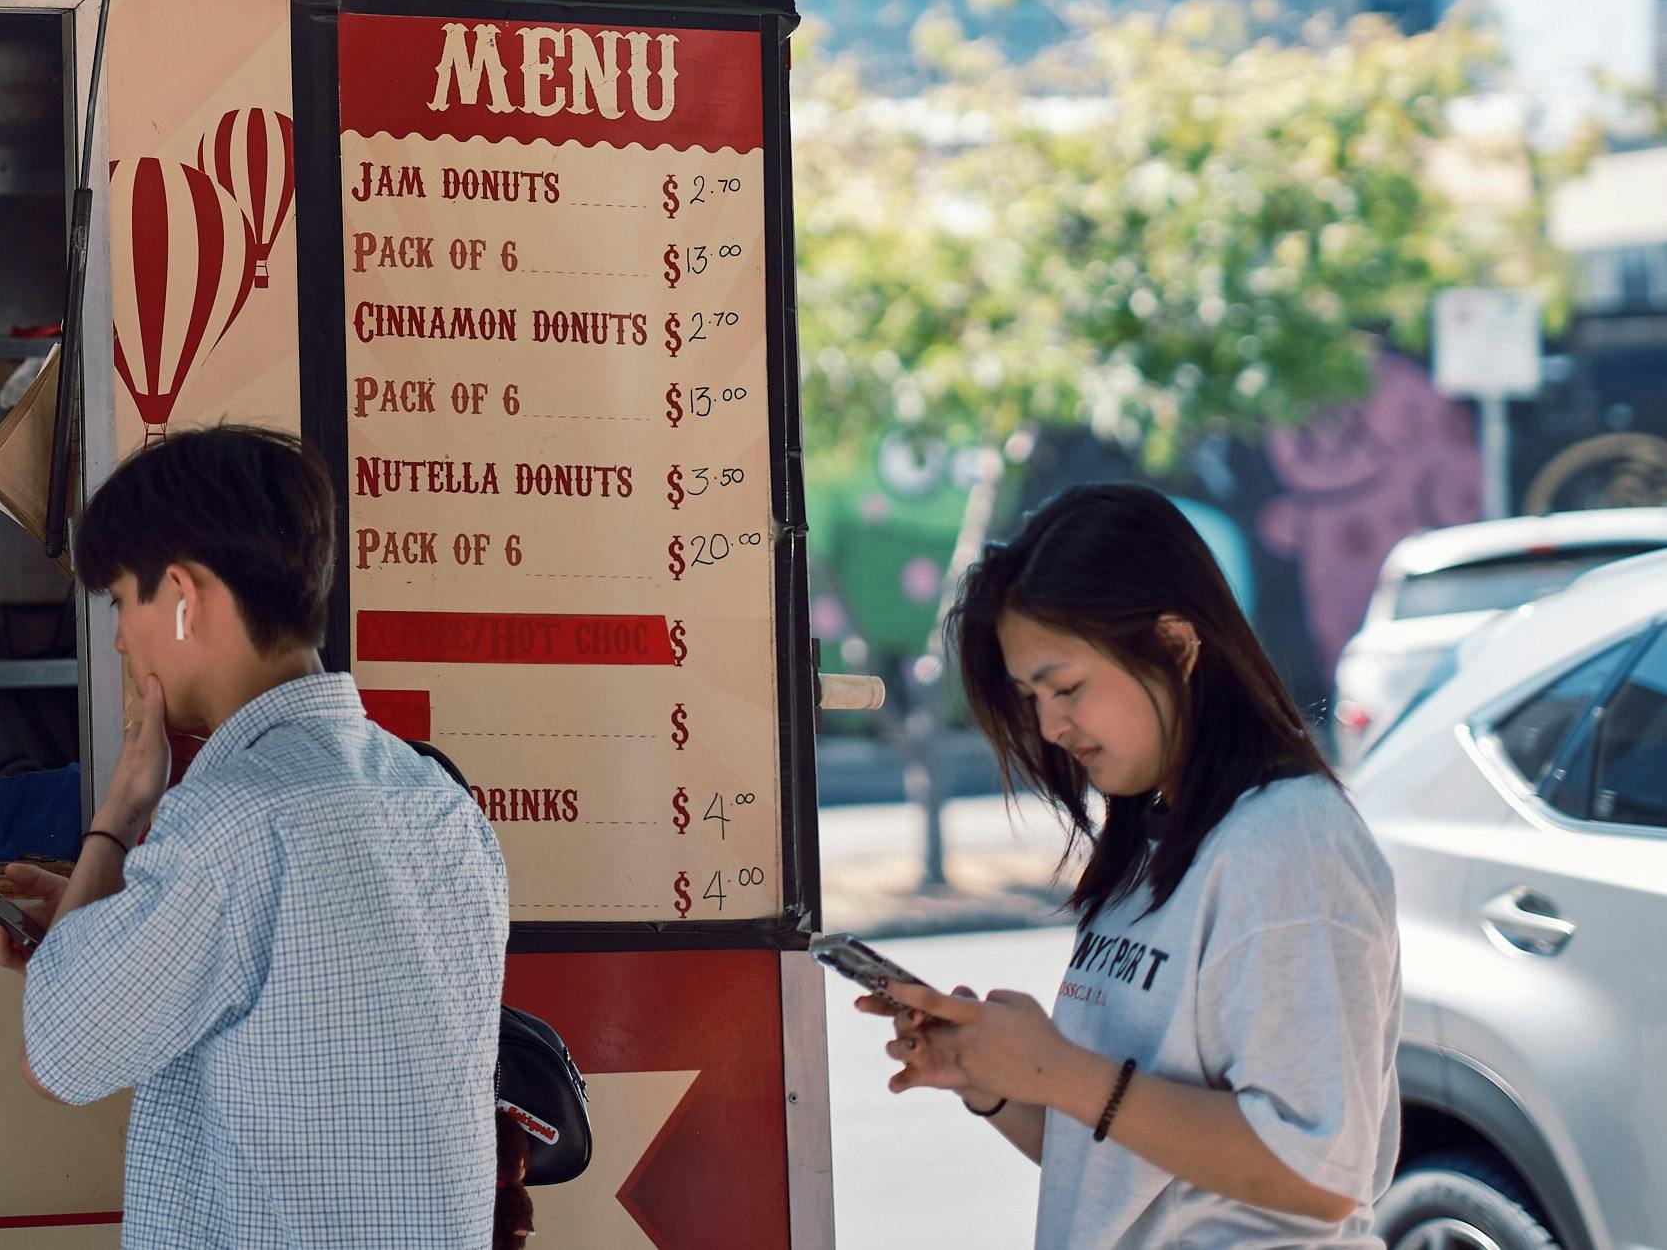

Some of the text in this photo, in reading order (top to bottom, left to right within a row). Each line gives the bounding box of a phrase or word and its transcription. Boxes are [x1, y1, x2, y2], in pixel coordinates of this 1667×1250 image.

[426, 23, 679, 121] MENU
[352, 162, 559, 203] JAM DONUTS
[353, 233, 518, 272] PACK OF 6
[353, 301, 647, 345] CINNAMON DONUTS
[354, 377, 520, 417] PACK OF 6
[355, 456, 632, 498] NUTELLA DONUTS
[356, 529, 522, 569] PACK OF 6
[671, 703, 689, 750] $
